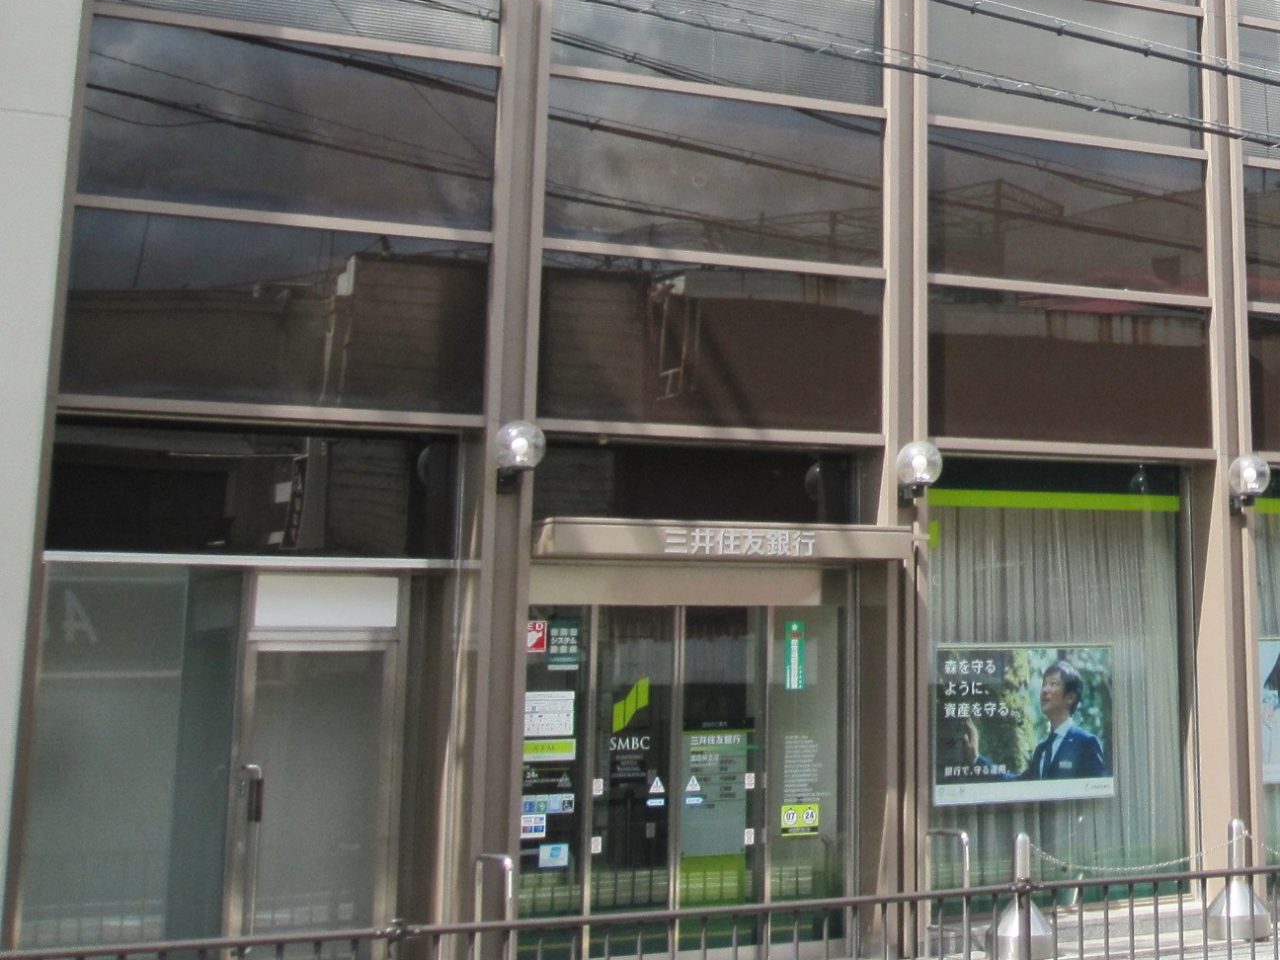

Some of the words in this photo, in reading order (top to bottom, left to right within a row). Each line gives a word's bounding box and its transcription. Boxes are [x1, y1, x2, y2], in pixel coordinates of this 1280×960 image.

[664, 528, 816, 556] 三井住友銀行
[527, 622, 544, 631] ED
[944, 659, 997, 674] 森を守る
[945, 681, 990, 696] ように、
[609, 735, 651, 751] SMBC
